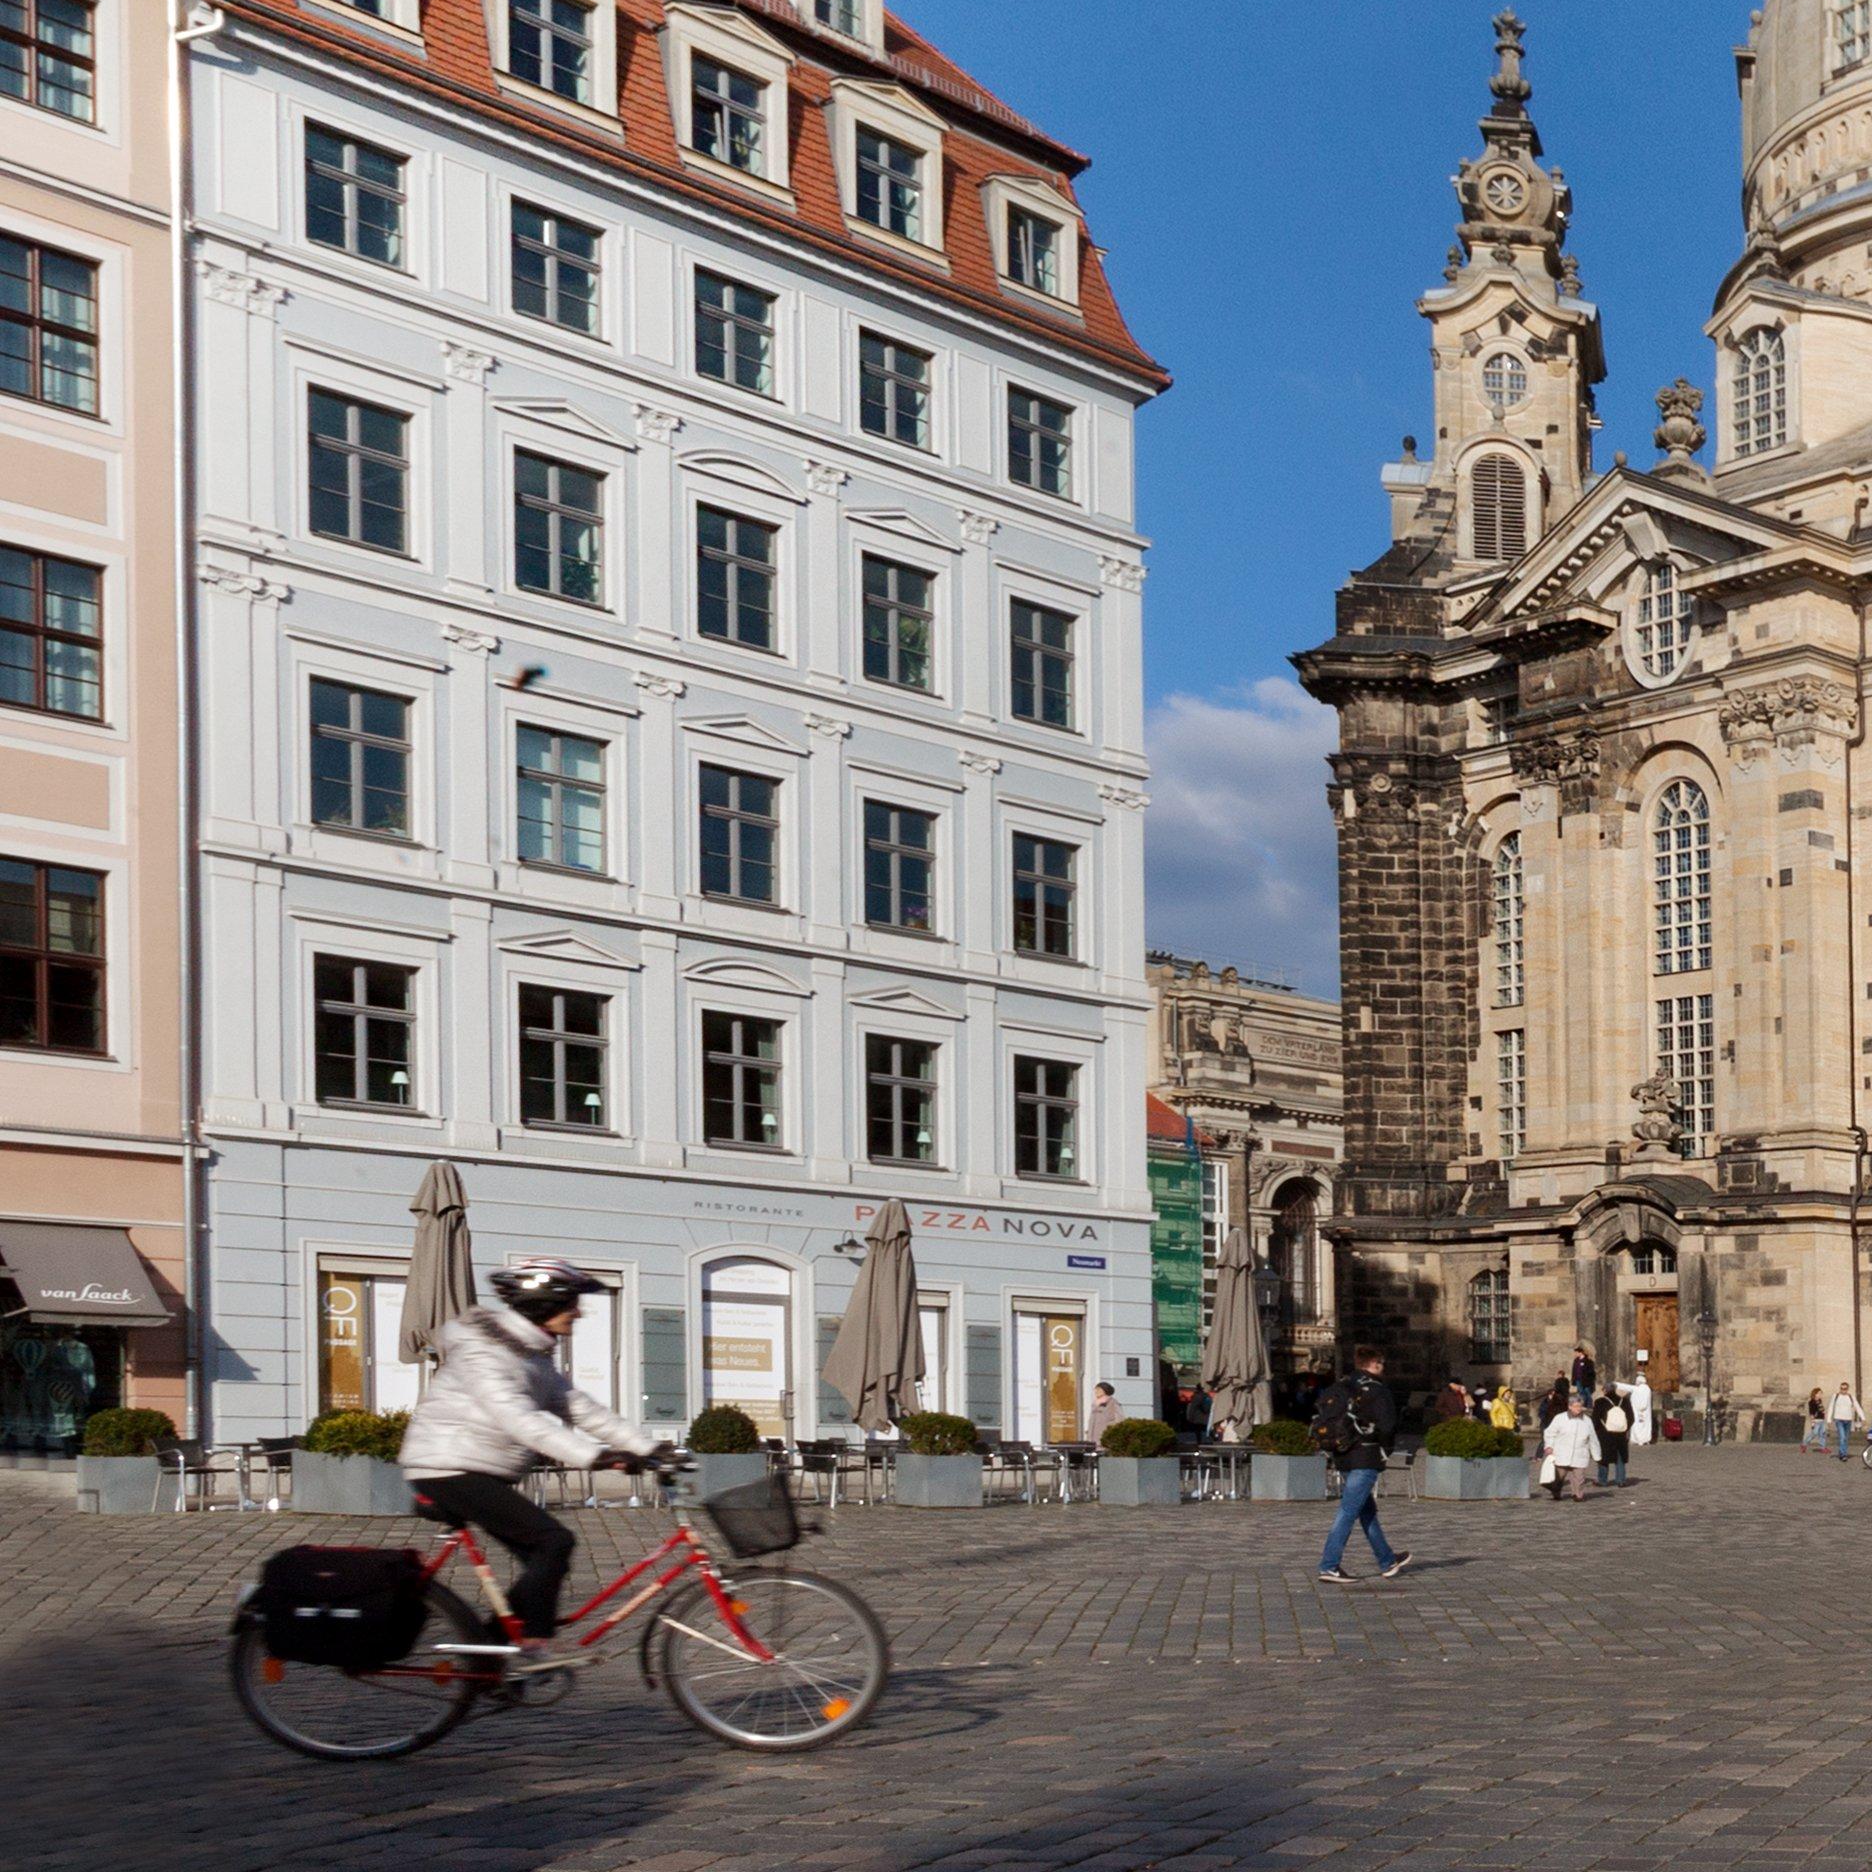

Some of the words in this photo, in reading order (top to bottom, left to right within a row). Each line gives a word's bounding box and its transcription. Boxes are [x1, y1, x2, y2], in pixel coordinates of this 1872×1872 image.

[694, 1201, 803, 1217] RISTORANTE
[855, 1205, 991, 1232] PZZA
[1003, 1218, 1098, 1241] NOVA
[1072, 1257, 1102, 1267] Neumarkt
[1649, 1276, 1657, 1287] D
[40, 1289, 76, 1299] van
[72, 1282, 142, 1305] Laack
[324, 1286, 358, 1336] QF
[1051, 1324, 1073, 1364] QF
